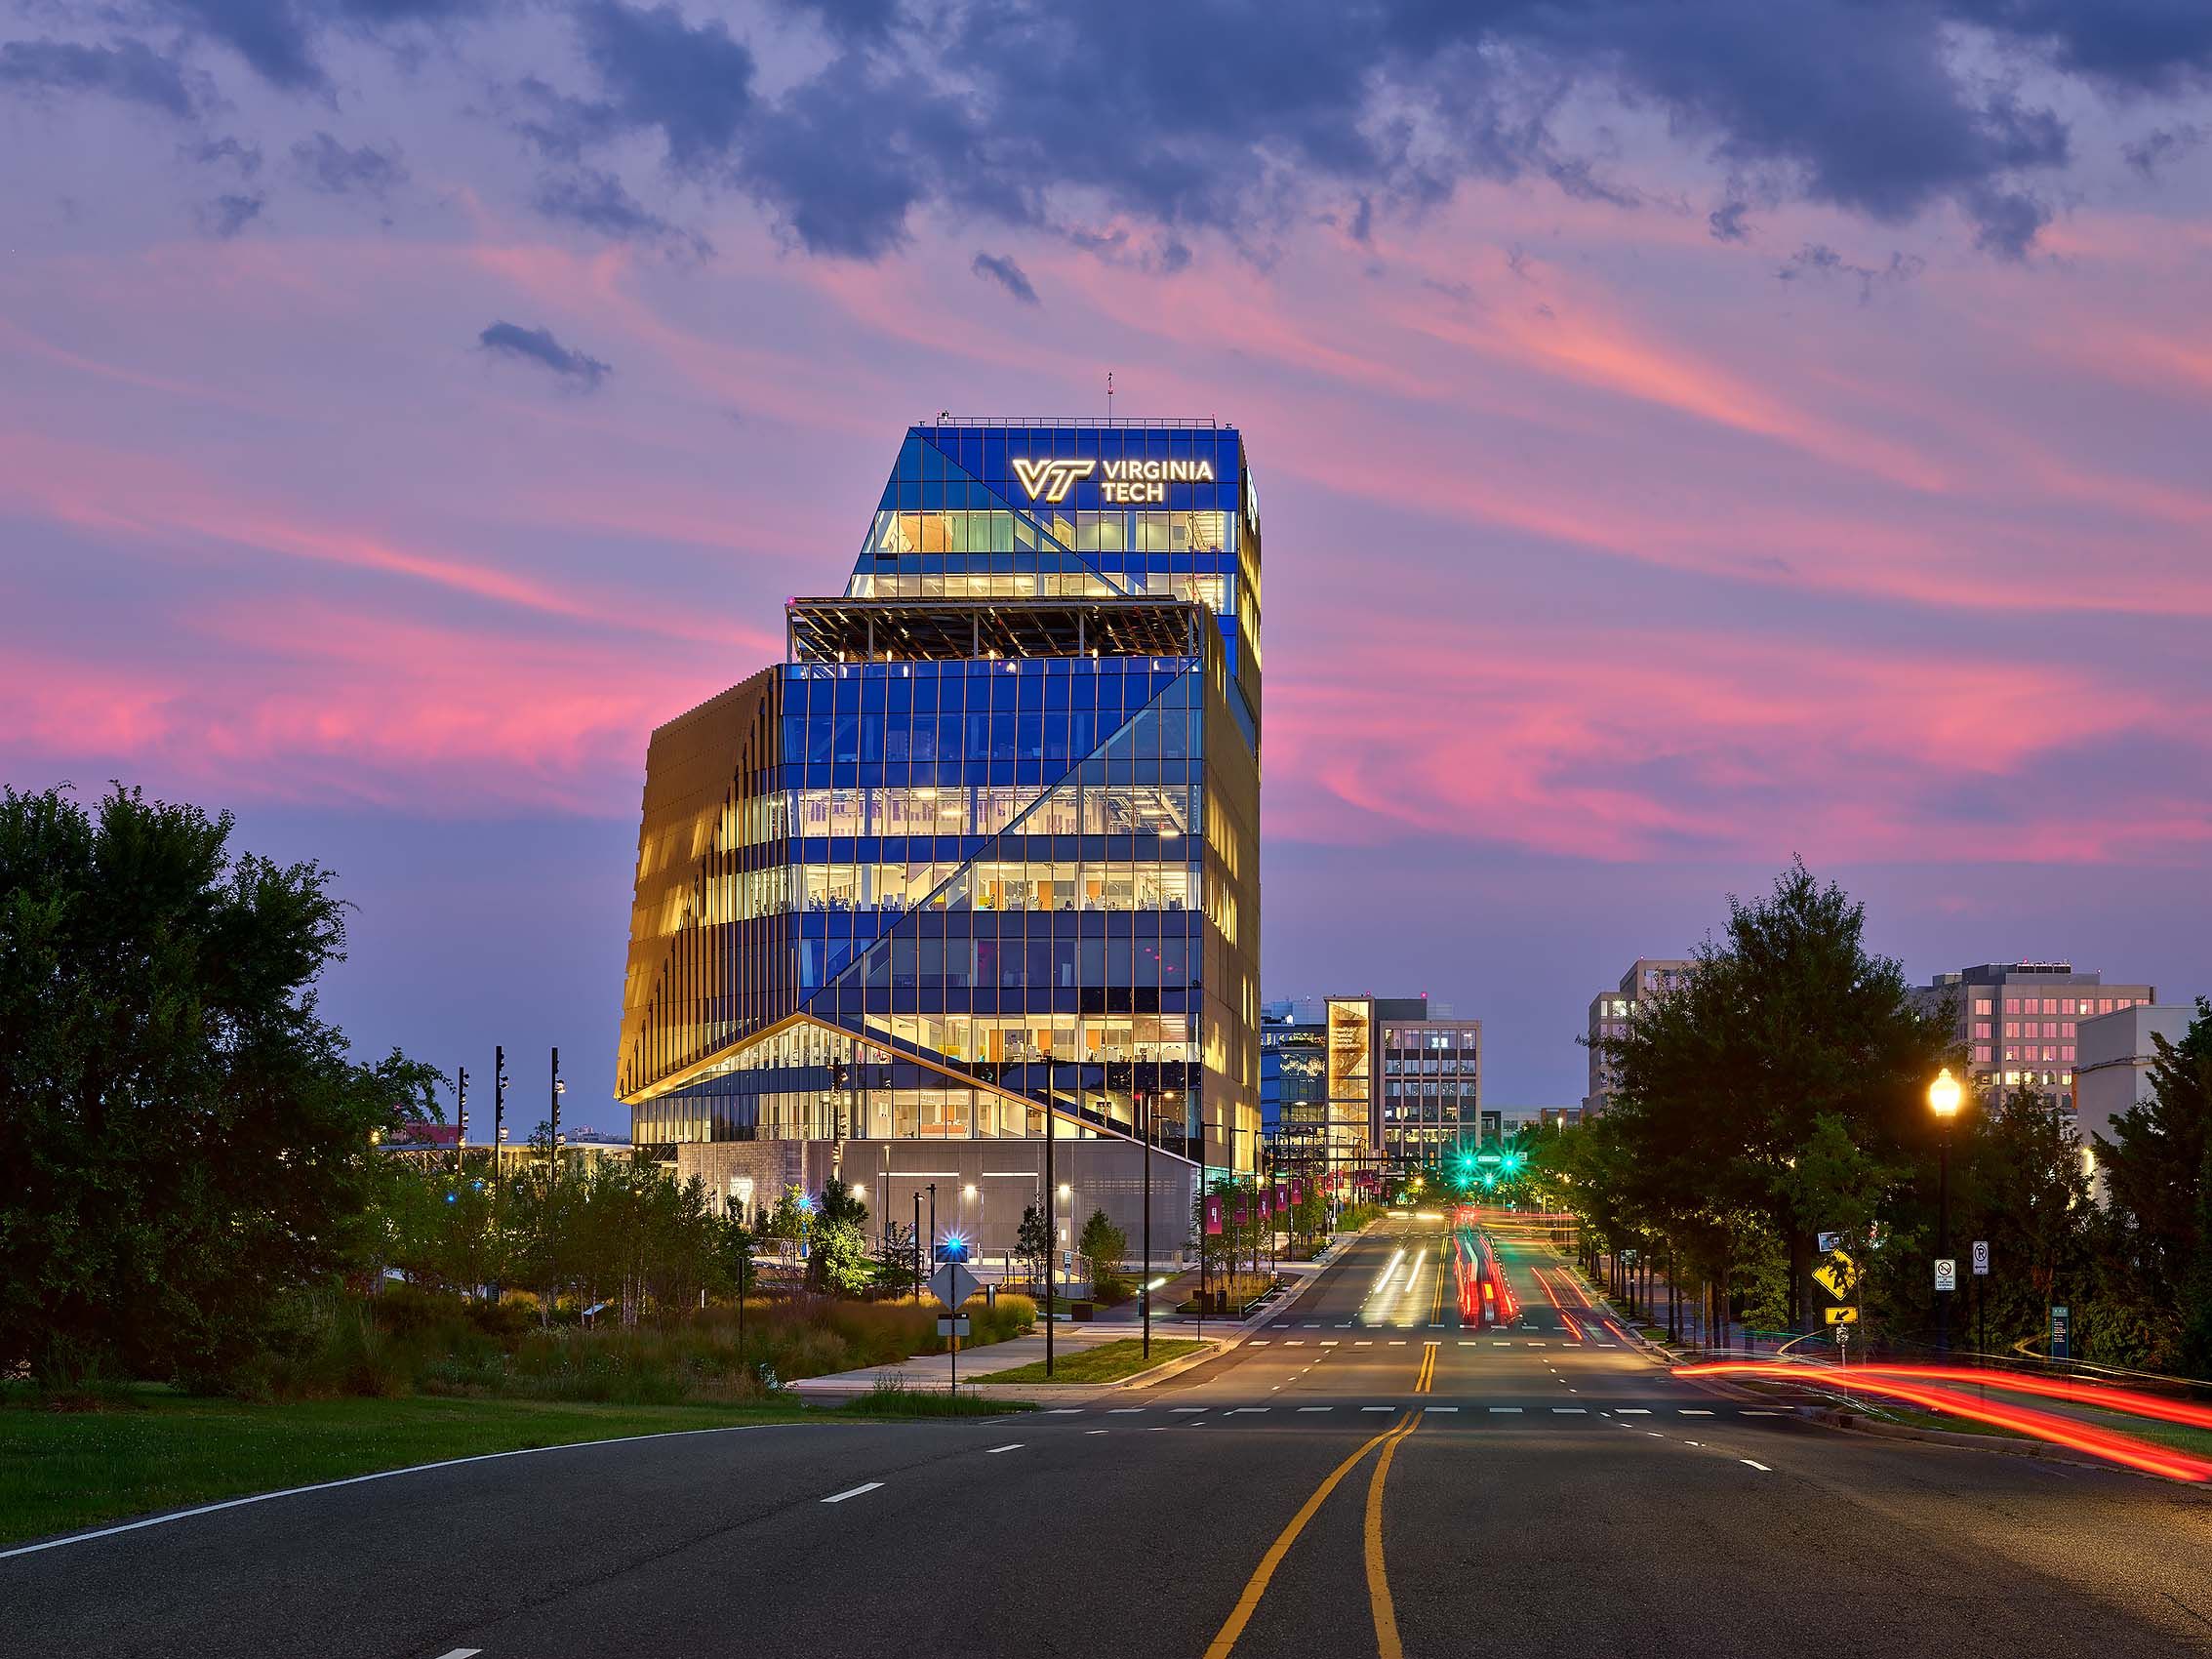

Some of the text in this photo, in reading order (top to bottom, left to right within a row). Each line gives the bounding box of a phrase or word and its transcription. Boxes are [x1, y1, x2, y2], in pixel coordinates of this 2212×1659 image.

[1103, 461, 1214, 480] VIRGINIA
[1013, 460, 1096, 503] VT
[1102, 482, 1164, 502] TECH
